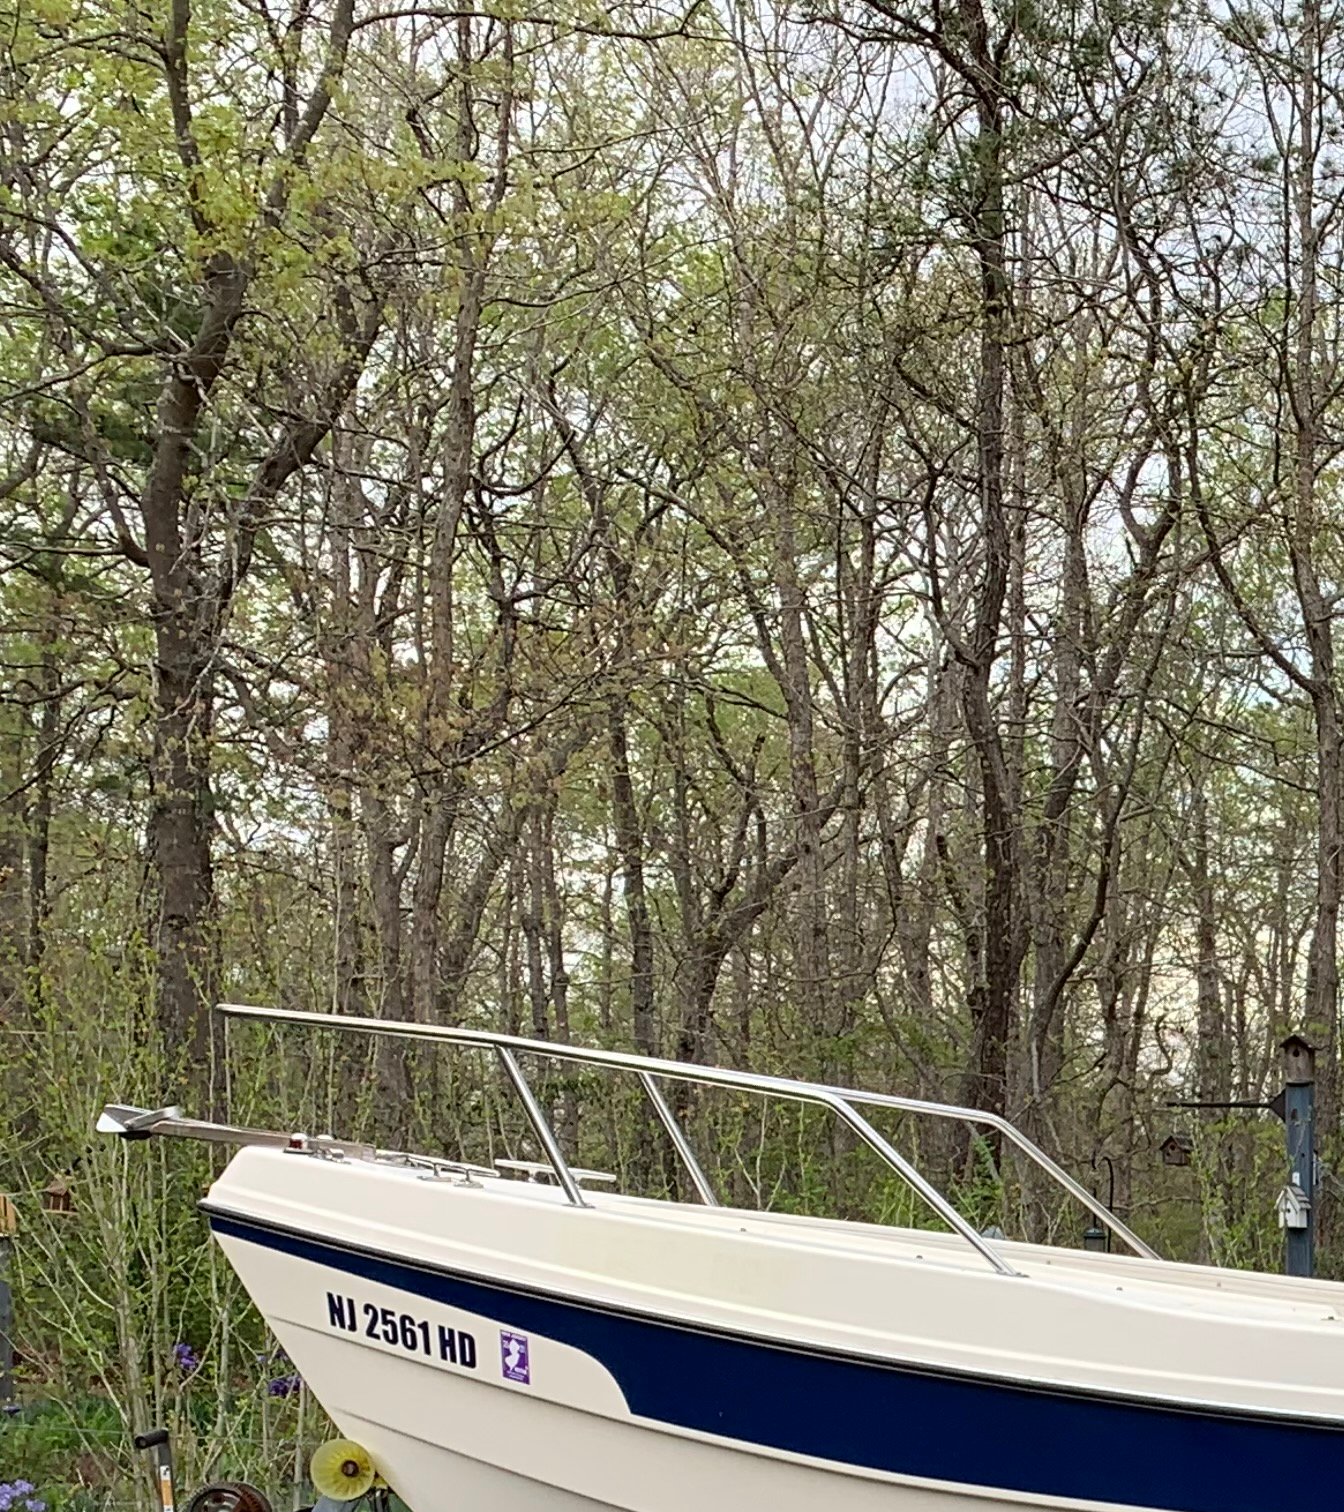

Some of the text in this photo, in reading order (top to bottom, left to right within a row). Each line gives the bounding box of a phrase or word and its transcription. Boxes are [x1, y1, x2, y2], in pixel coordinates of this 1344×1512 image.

[327, 1292, 476, 1368] NJ 2561 HD
